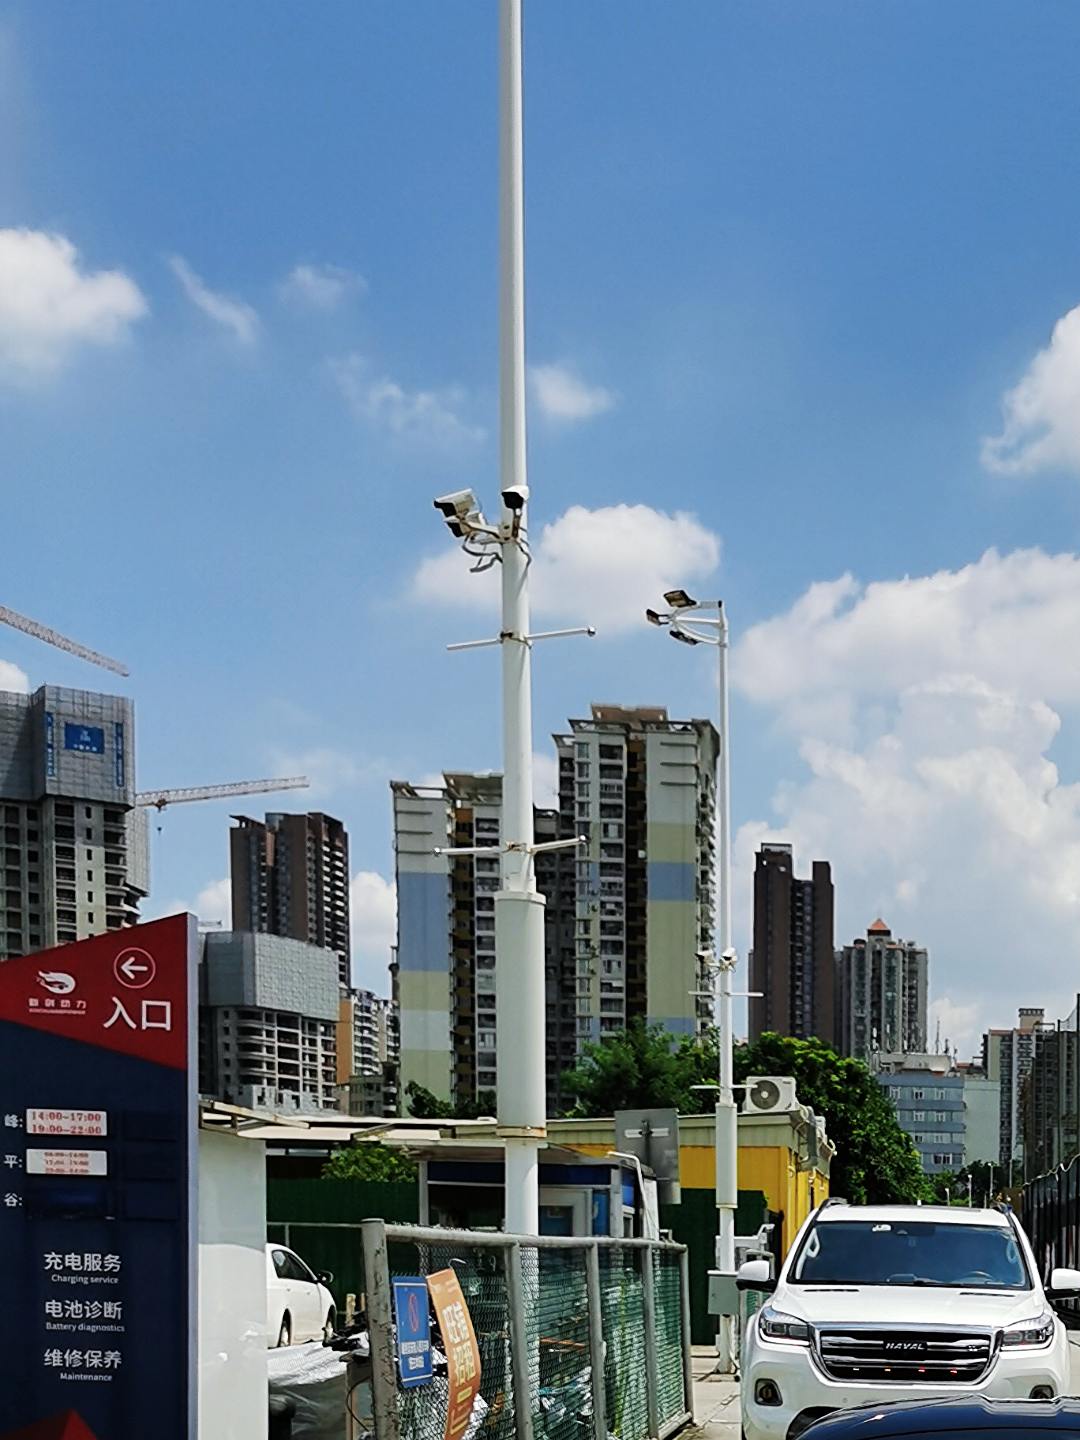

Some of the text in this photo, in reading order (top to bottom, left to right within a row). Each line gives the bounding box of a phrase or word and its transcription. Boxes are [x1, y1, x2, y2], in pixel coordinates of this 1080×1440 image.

[103, 996, 171, 1031] 入口
[43, 1251, 122, 1272] 充电服务
[51, 1274, 119, 1285] Charging service
[45, 1299, 123, 1320] 电池诊断
[46, 1322, 125, 1333] Battery diagnostics
[885, 1342, 925, 1351] HAVAL
[43, 1348, 122, 1369] 维修保养
[60, 1372, 113, 1382] Maintenance
